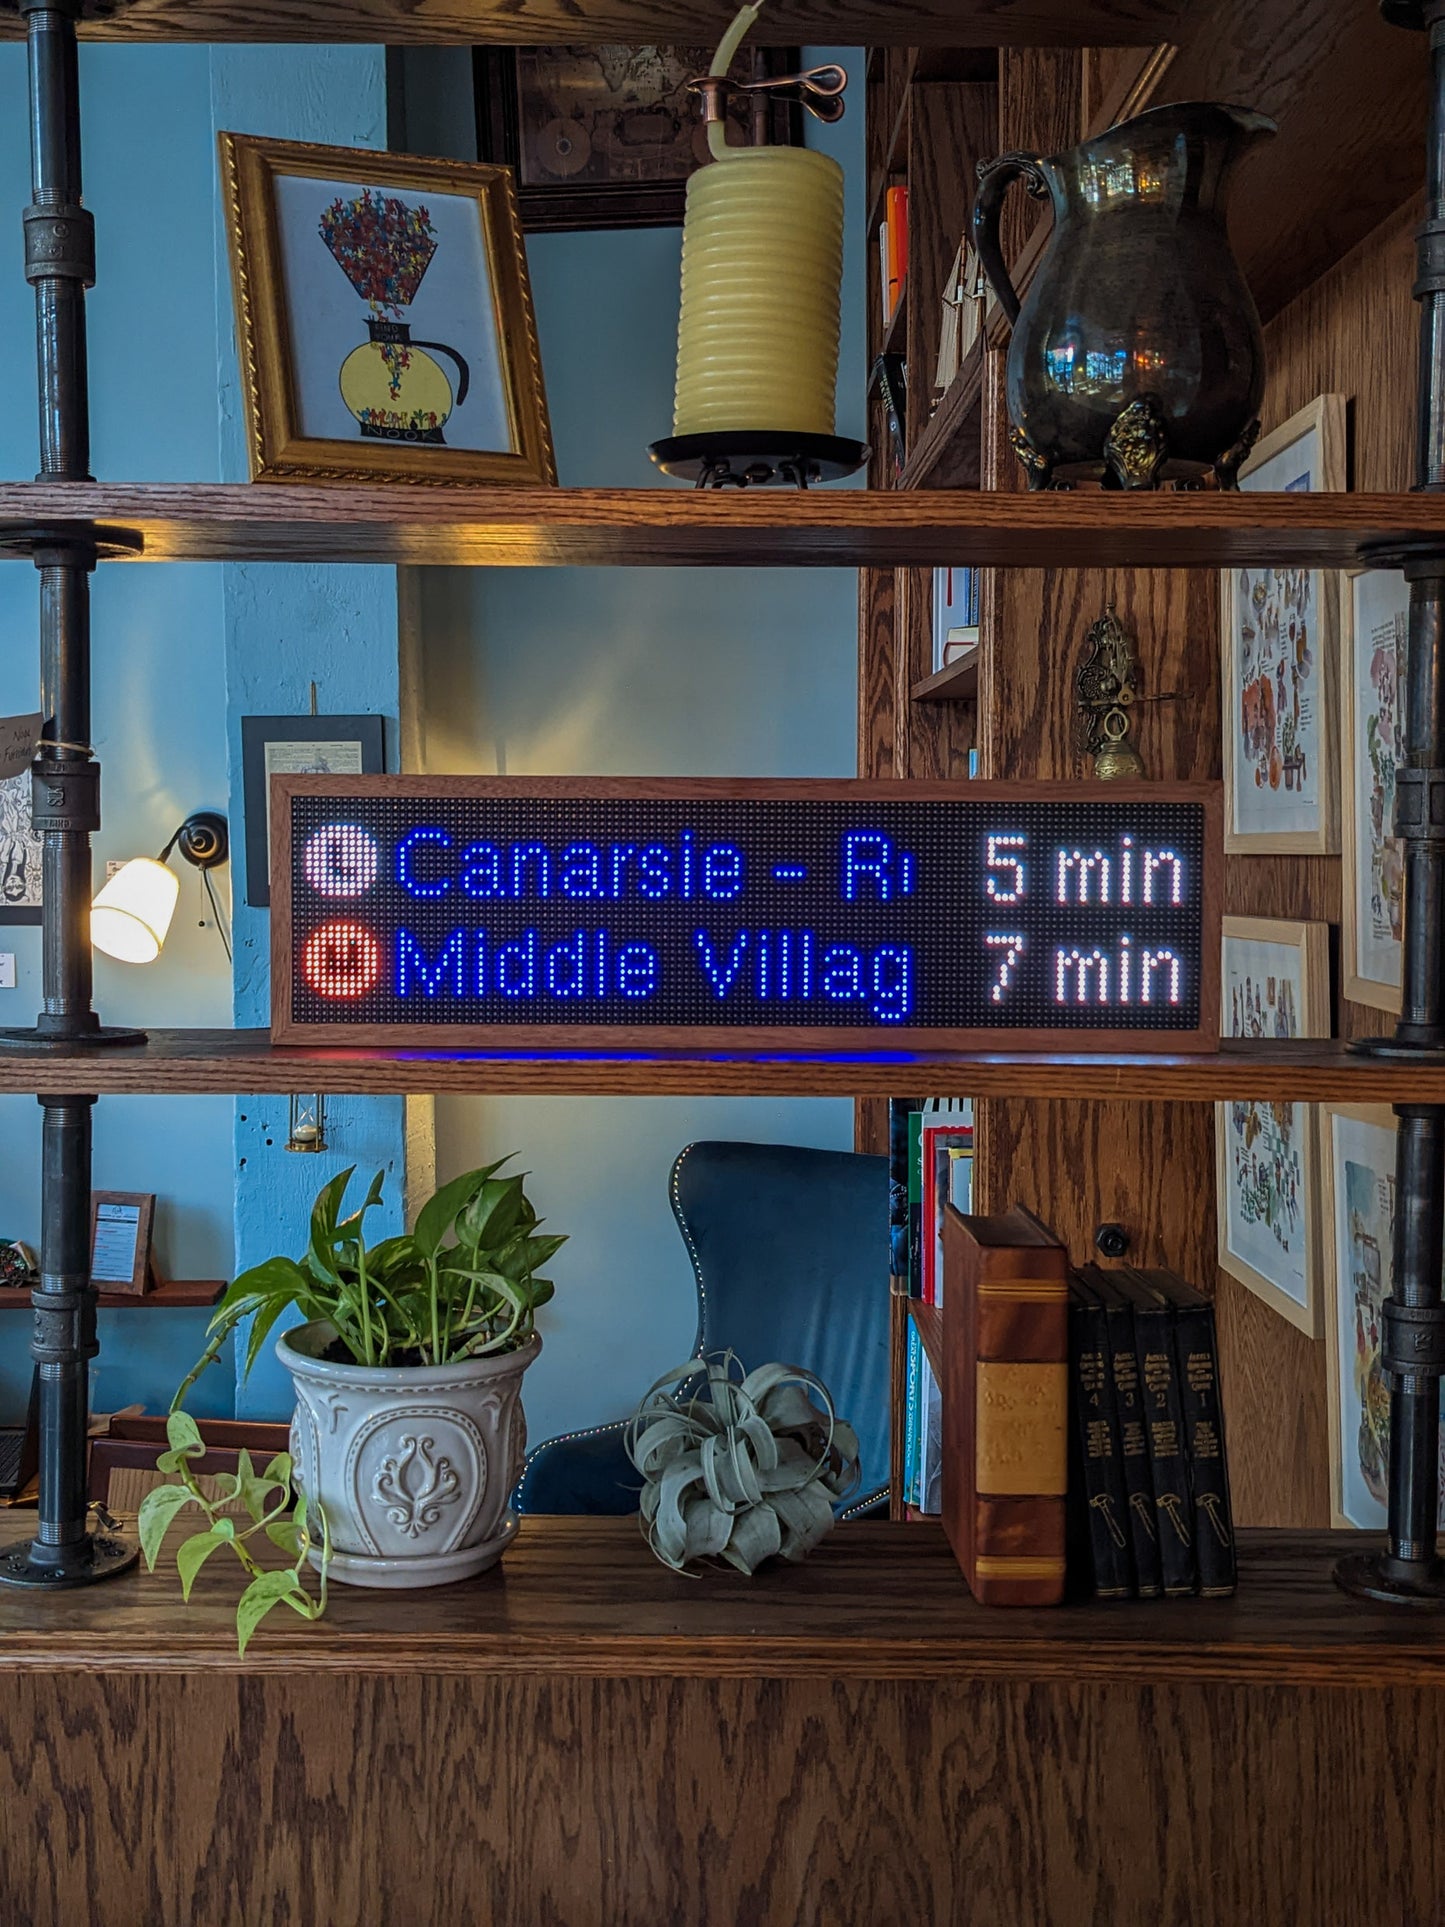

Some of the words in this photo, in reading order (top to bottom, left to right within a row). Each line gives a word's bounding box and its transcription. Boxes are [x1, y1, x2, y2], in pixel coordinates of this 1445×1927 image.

[367, 425, 438, 441] NOOK
[398, 828, 743, 898] Canarsie
[987, 836, 1024, 901] 5
[1057, 834, 1181, 903] min
[398, 931, 656, 997] Middle
[697, 930, 911, 1021] Villag
[985, 935, 1022, 1002] 7
[1056, 934, 1179, 1003] min
[1089, 1393, 1099, 1407] 4
[1125, 1392, 1135, 1408] 3
[1156, 1393, 1166, 1408] 2
[1200, 1392, 1207, 1408] 1
